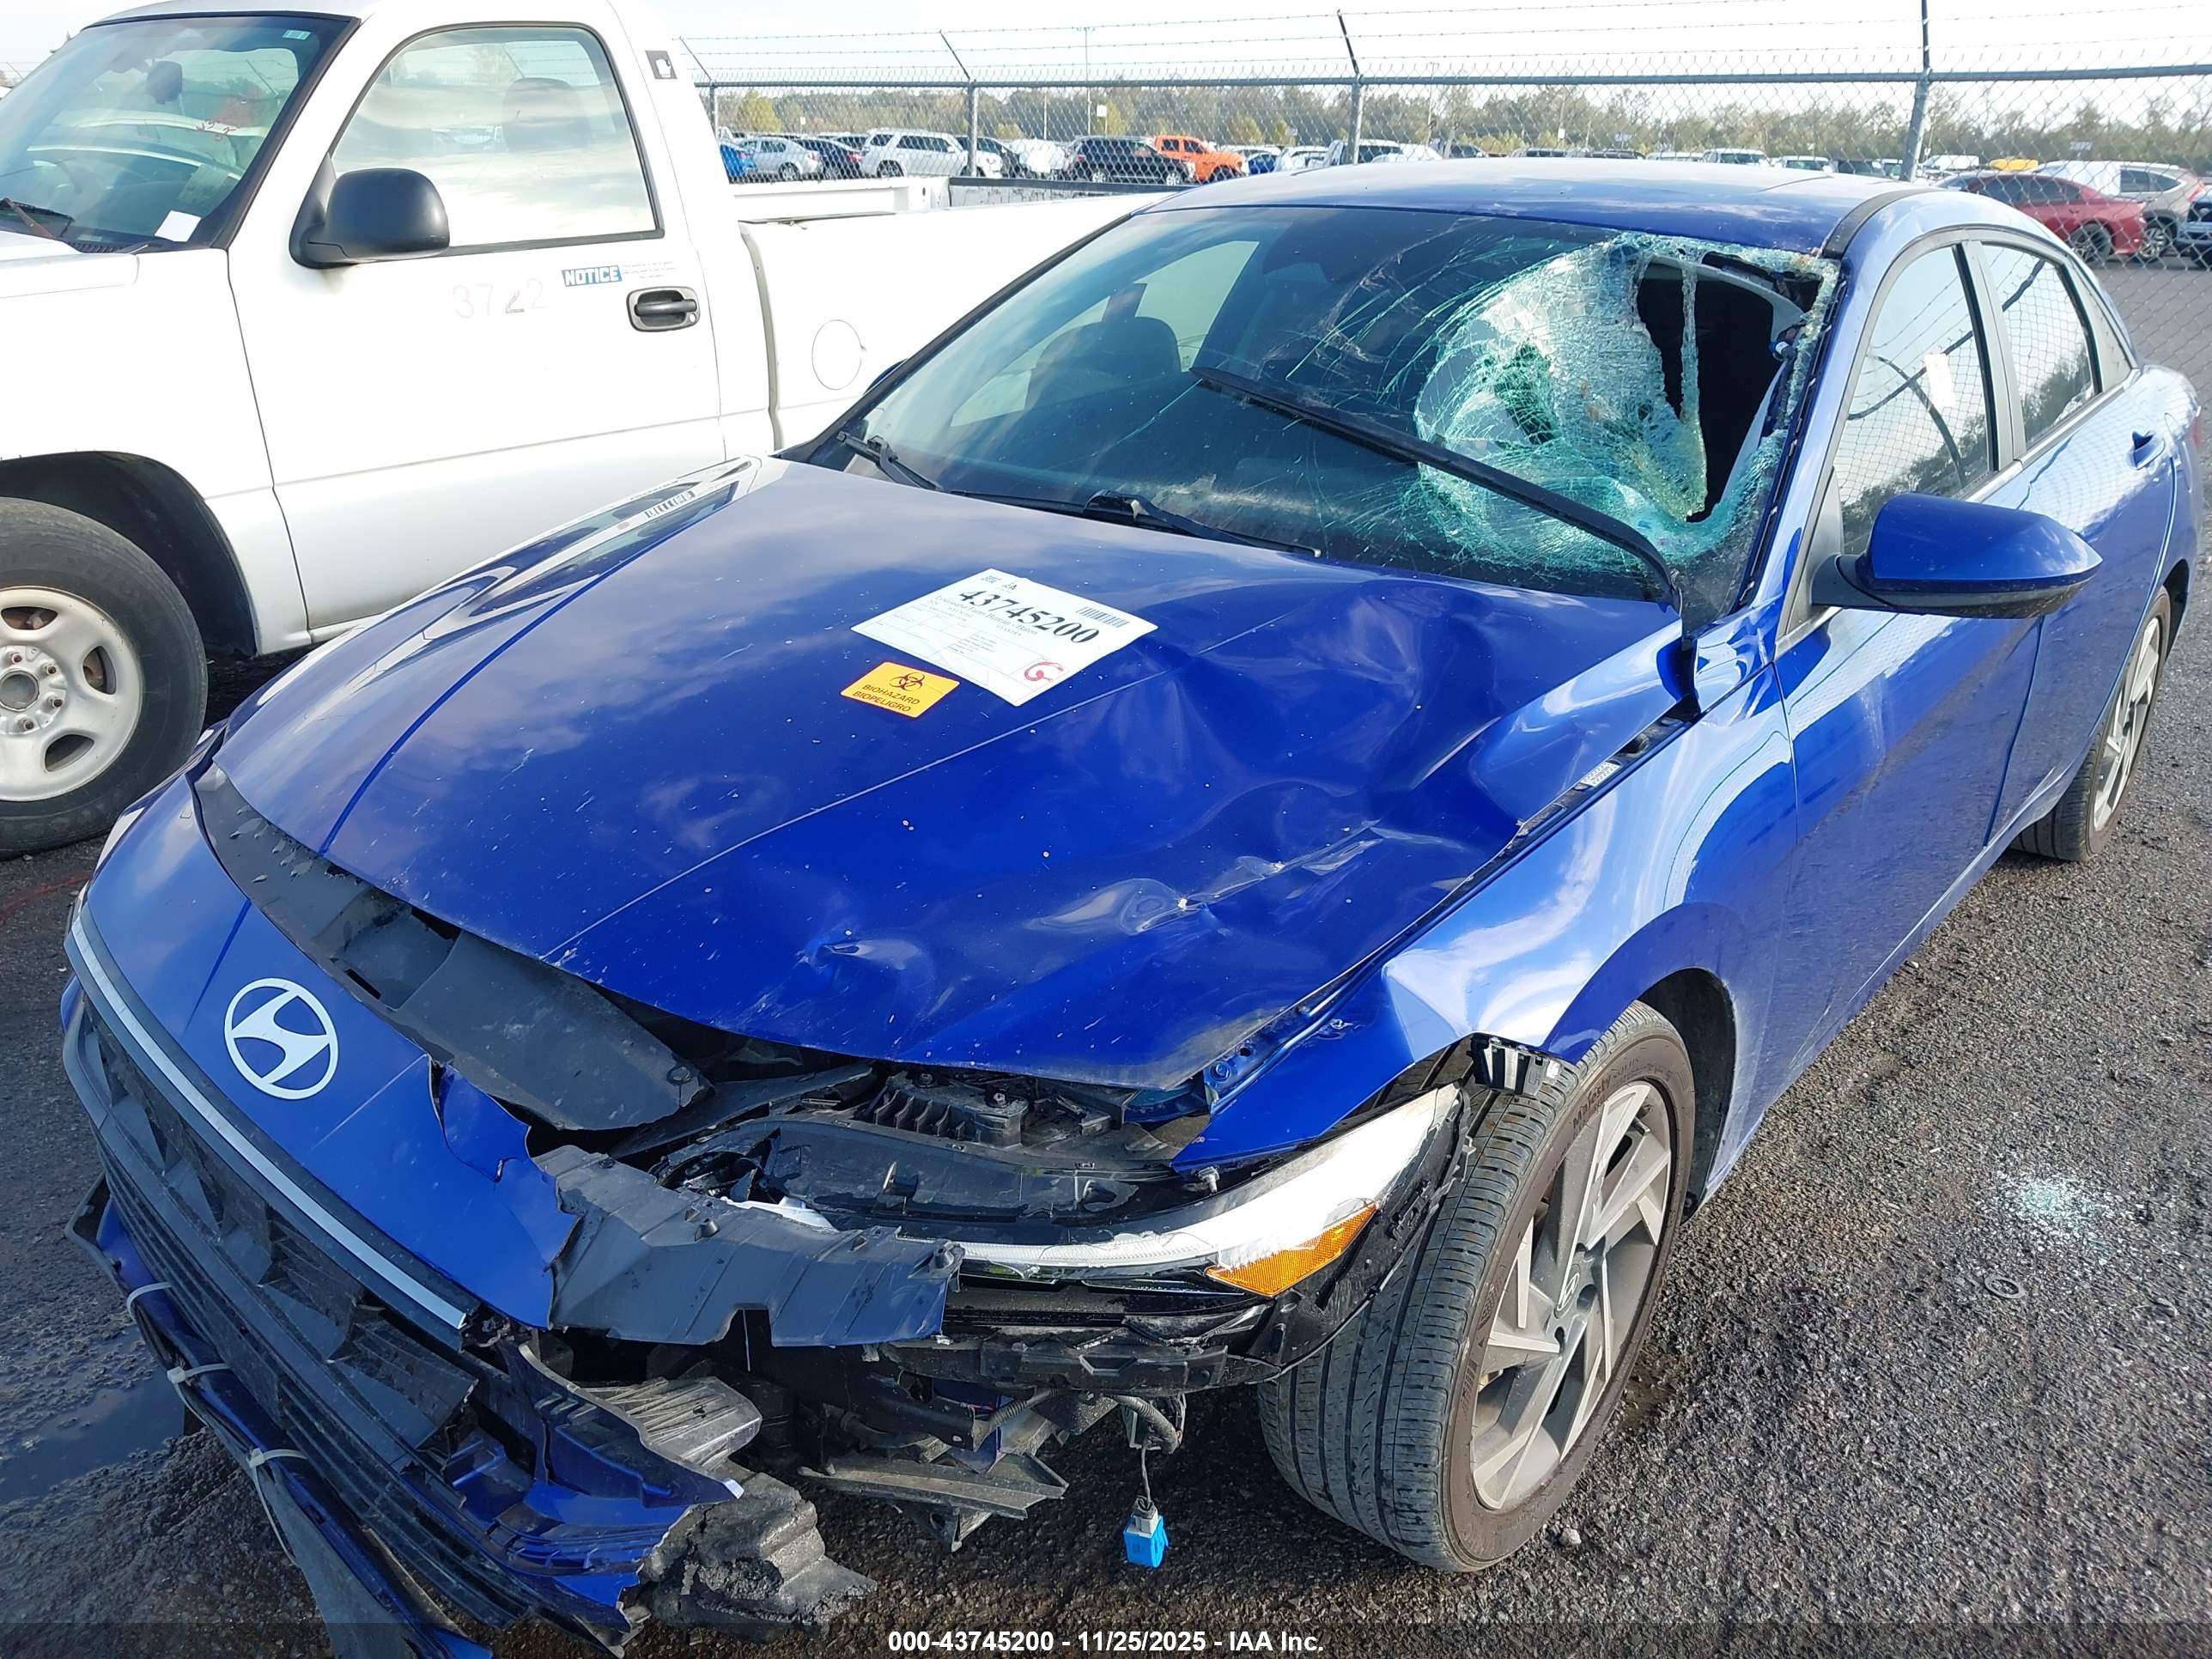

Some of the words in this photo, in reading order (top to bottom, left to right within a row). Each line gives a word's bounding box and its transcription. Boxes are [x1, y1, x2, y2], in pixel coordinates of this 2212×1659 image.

[564, 266, 620, 287] NOTICE
[958, 590, 1100, 643] 43745200
[852, 690, 912, 713] BIOPELIGRO
[861, 684, 921, 705] BIOHAZARD
